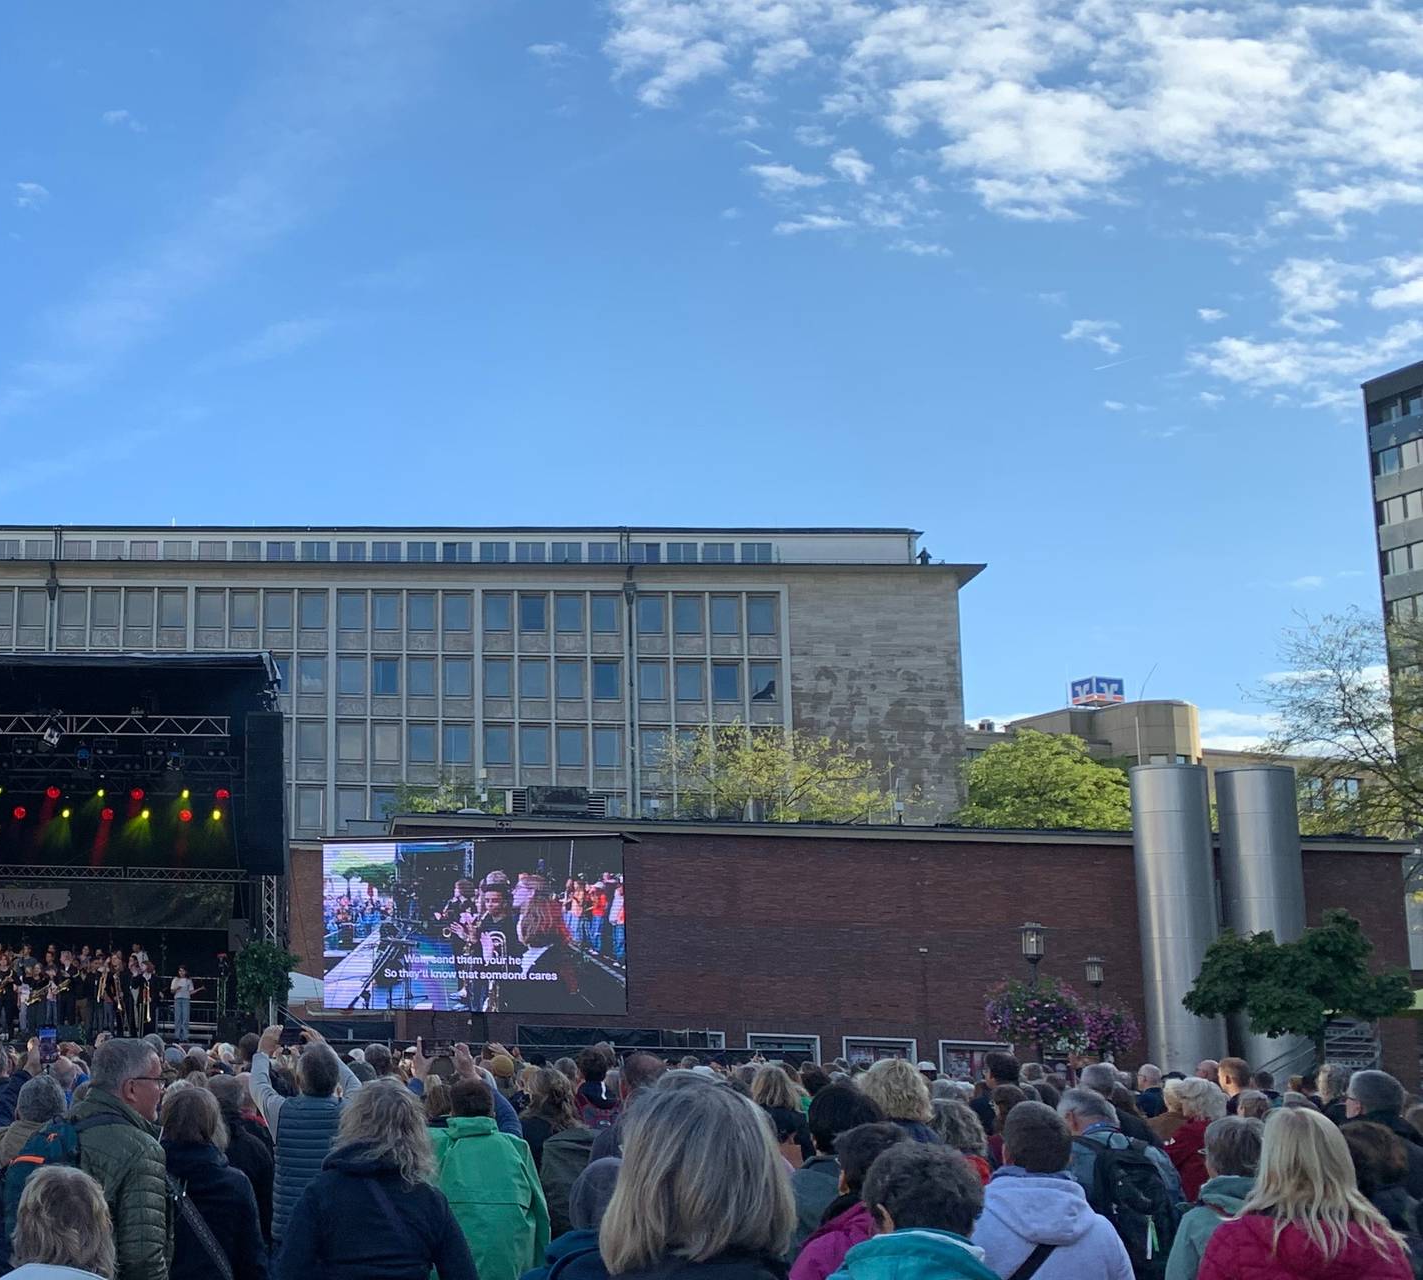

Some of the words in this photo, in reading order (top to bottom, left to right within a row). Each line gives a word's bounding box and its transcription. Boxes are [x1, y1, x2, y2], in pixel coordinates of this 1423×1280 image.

[431, 955, 455, 965] send
[457, 956, 483, 966] them
[484, 957, 507, 967] your
[384, 969, 397, 977] So
[399, 969, 429, 980] they'll
[430, 970, 457, 979] know
[458, 970, 479, 979] that
[480, 972, 527, 981] someone
[529, 973, 558, 981] cares
